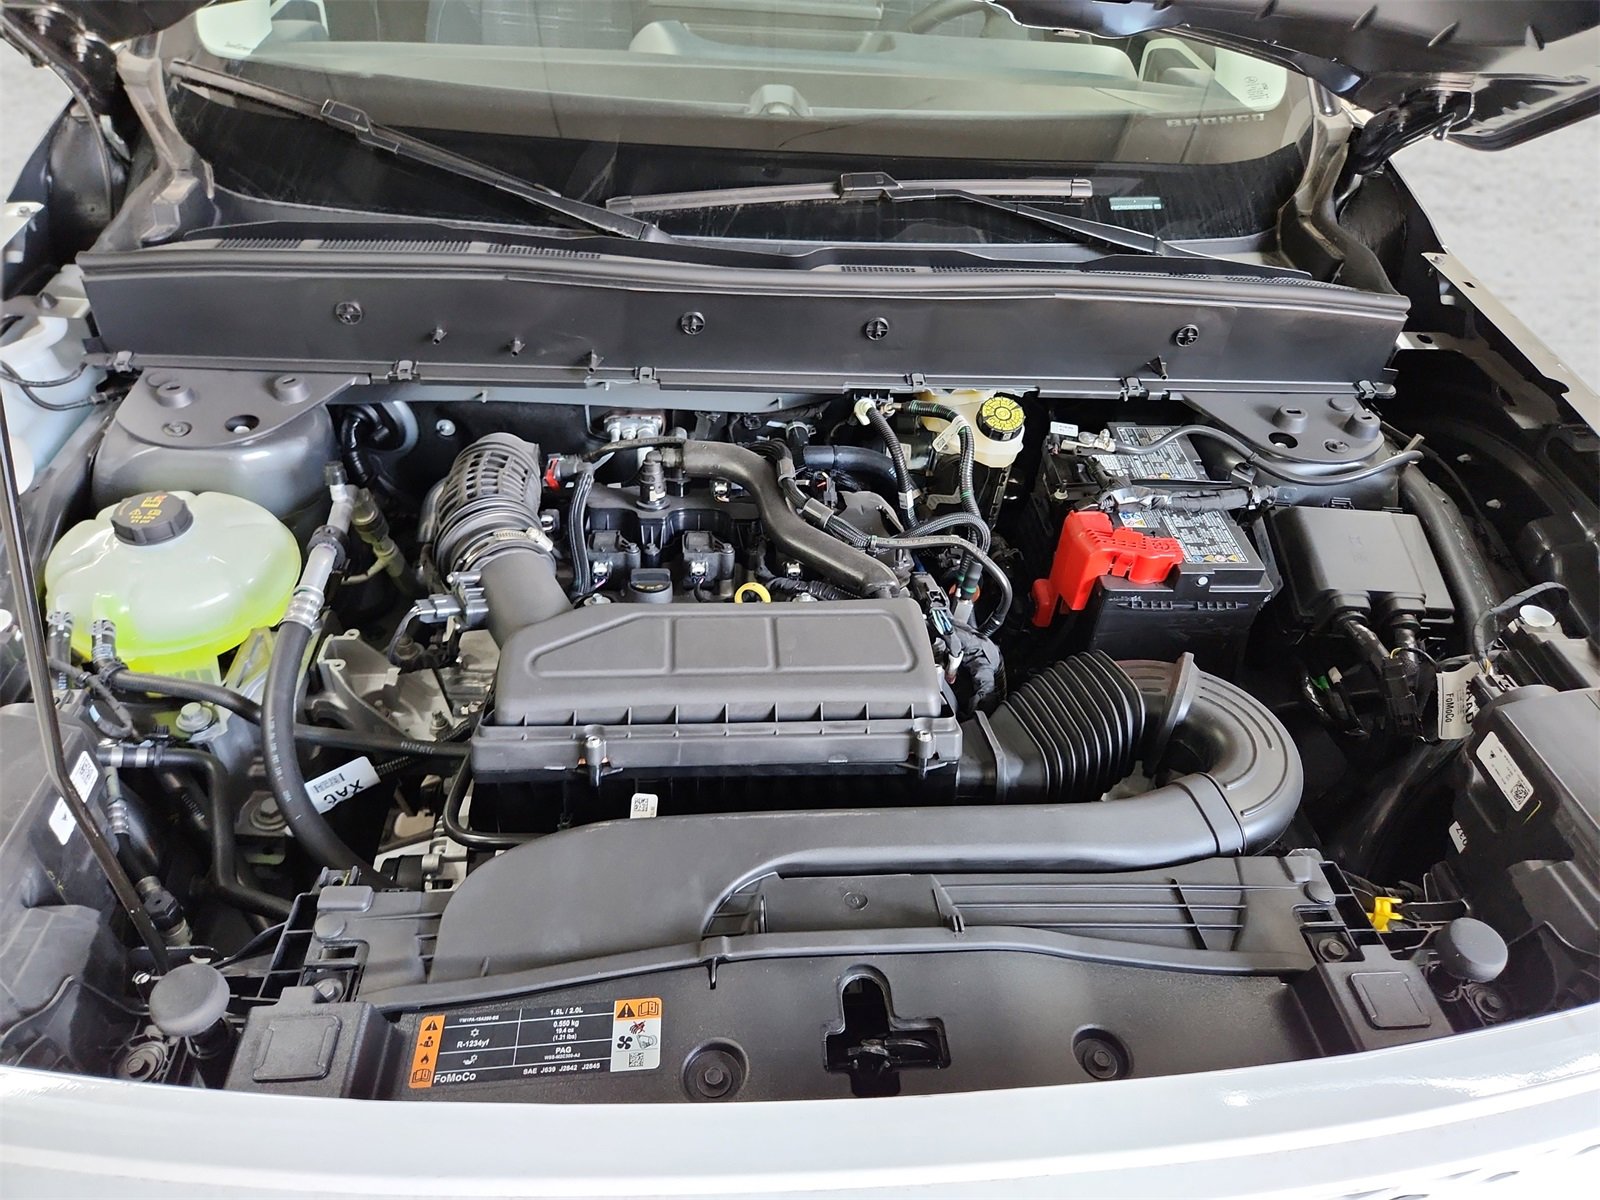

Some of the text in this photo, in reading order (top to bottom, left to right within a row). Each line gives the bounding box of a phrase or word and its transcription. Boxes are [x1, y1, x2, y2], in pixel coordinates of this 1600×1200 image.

[1445, 693, 1455, 723] FoMoCo
[569, 1006, 584, 1014] 2.0L
[571, 1019, 580, 1028] kg
[456, 1038, 490, 1049] R-1234yf
[555, 1046, 572, 1054] PAG
[540, 1066, 556, 1074] J639
[433, 1071, 477, 1084] FoMoCo
